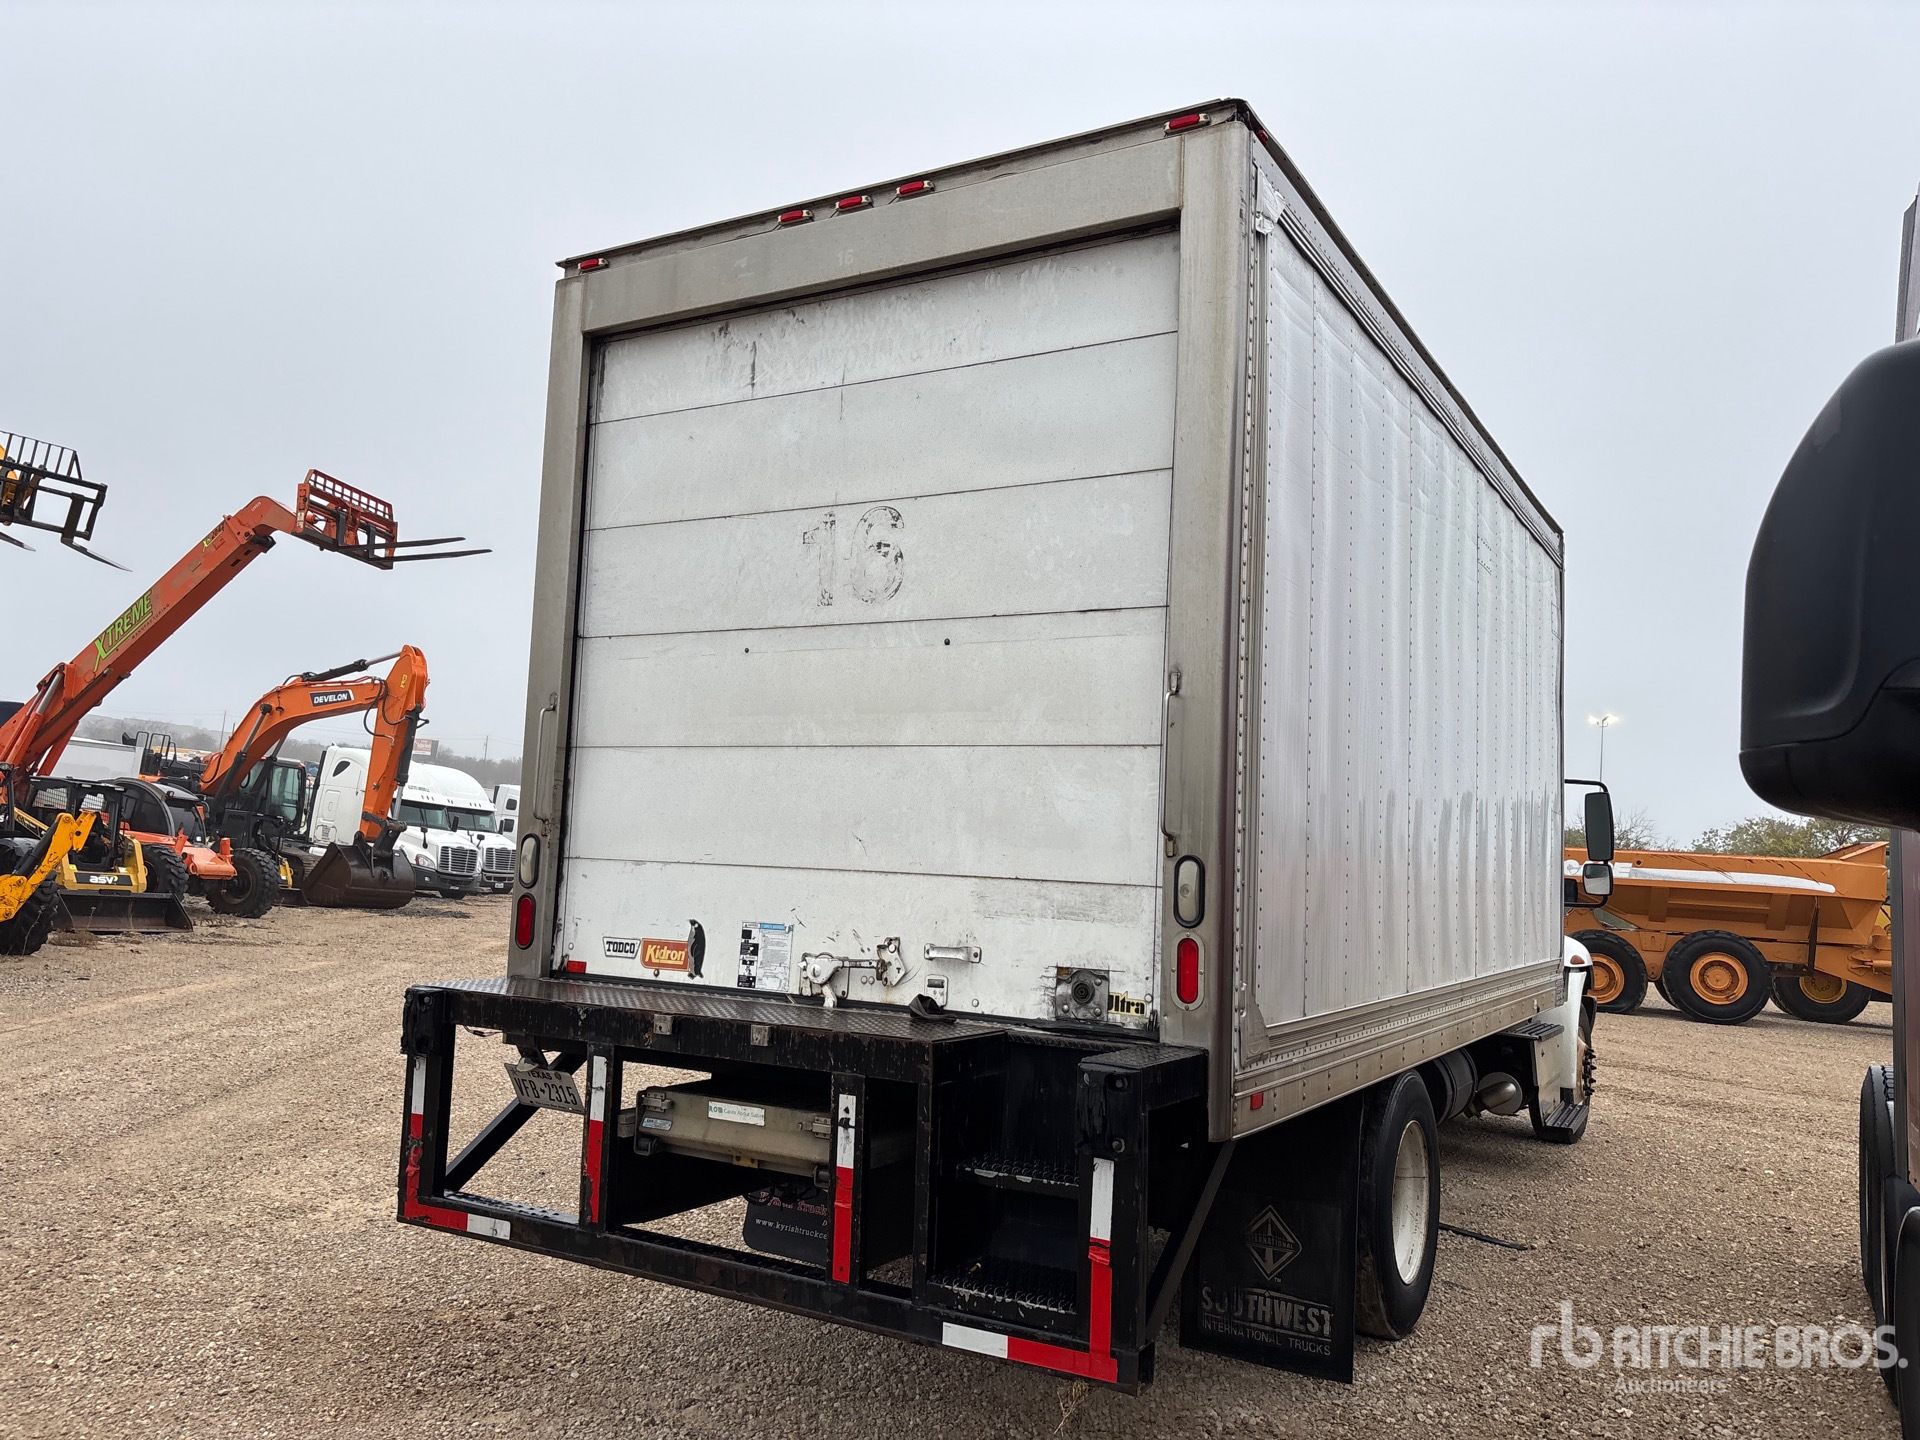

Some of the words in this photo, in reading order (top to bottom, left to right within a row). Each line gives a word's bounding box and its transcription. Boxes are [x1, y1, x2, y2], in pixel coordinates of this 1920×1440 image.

[802, 505, 905, 607] 16
[93, 589, 153, 673] XTREME
[313, 692, 348, 704] DEVELON
[605, 940, 636, 954] TODCO
[644, 943, 687, 964] Kidron
[1288, 1337, 1332, 1356] TRUCKS
